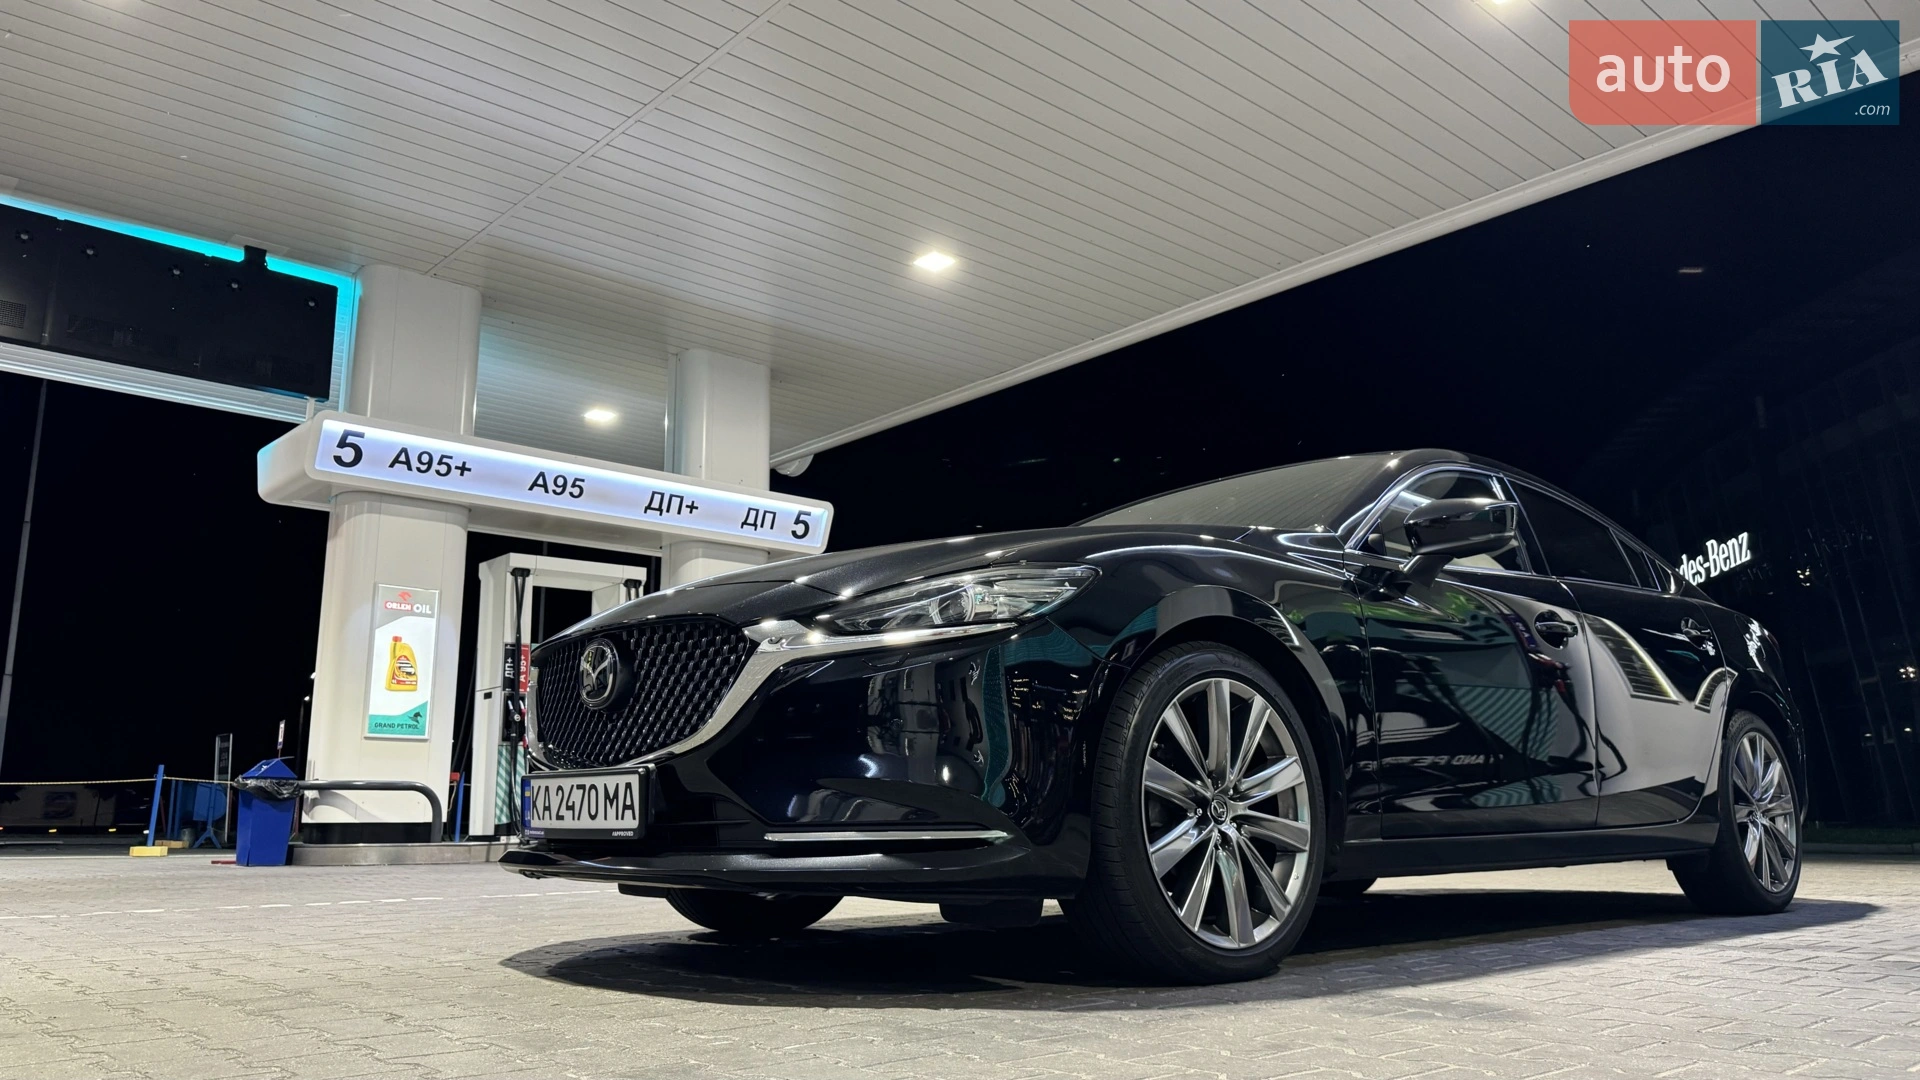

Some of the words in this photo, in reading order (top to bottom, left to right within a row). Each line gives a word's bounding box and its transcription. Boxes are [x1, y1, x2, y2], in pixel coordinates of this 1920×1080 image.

[332, 429, 365, 468] 5
[388, 446, 472, 478] A95+
[528, 471, 585, 499] A95
[644, 490, 699, 517] ДП+
[740, 507, 776, 532] ДП
[790, 510, 812, 541] 5
[1676, 531, 1752, 586] des-Benz
[386, 601, 411, 611] ORLEN
[413, 603, 432, 614] OIL
[532, 785, 552, 821] KA
[556, 783, 599, 821] 2470
[604, 782, 637, 821] MA
